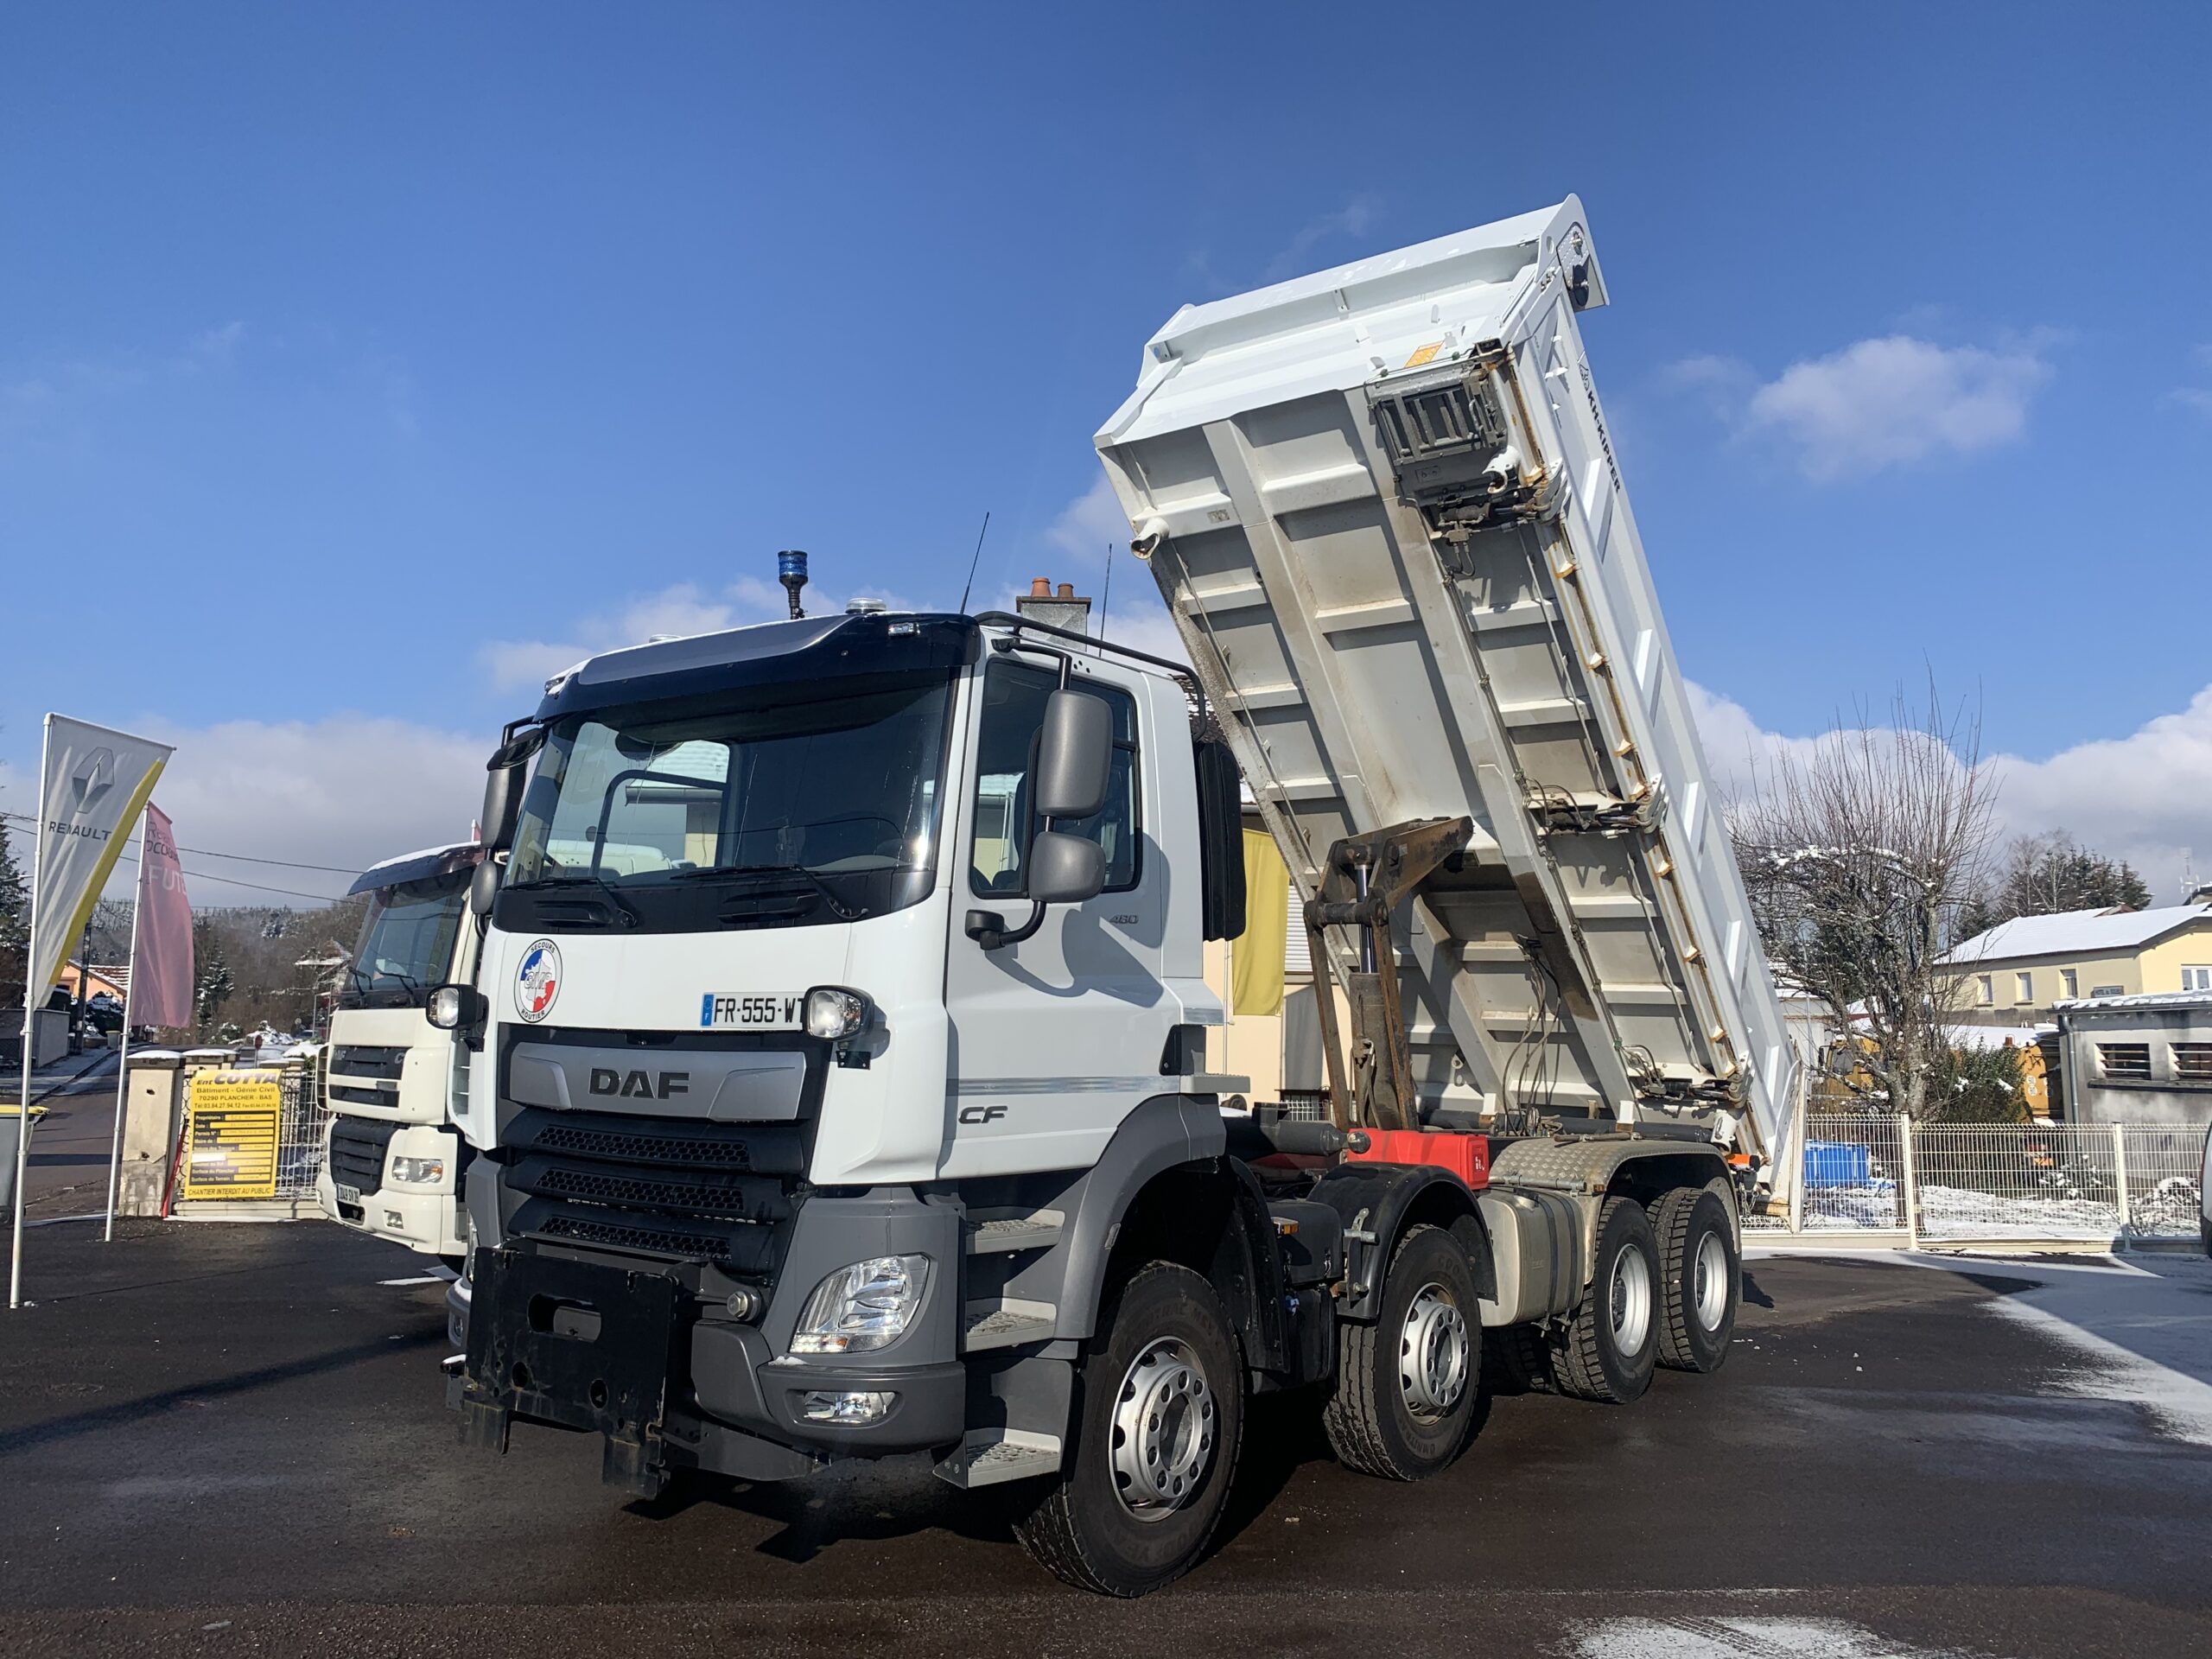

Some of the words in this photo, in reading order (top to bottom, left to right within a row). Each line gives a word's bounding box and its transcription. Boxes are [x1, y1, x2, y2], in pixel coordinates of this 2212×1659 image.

[1587, 391, 1620, 493] KH-KIPPER
[48, 821, 111, 841] RENAULT
[1109, 914, 1139, 925] 460
[531, 942, 555, 953] SECOURS
[521, 1009, 545, 1020] ROUTIER
[214, 1072, 276, 1084] COTTA
[588, 1067, 690, 1100] DAF
[958, 1106, 1007, 1124] CF
